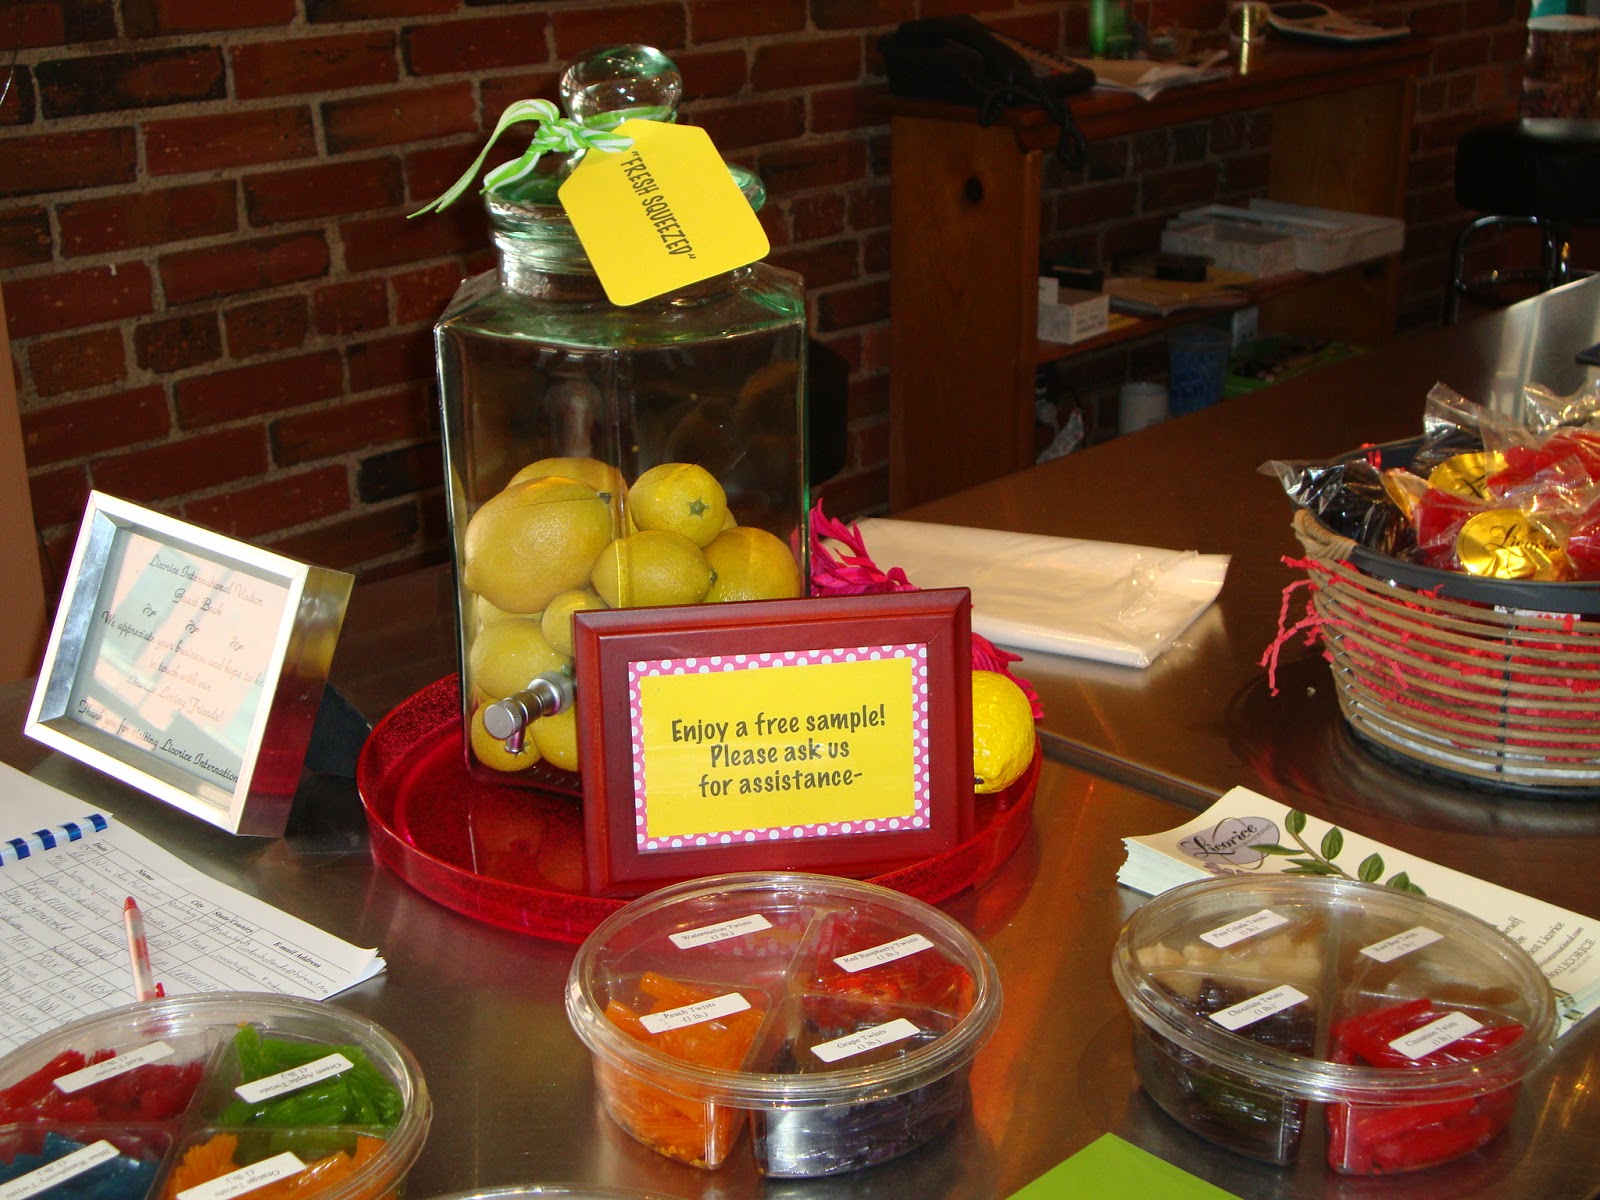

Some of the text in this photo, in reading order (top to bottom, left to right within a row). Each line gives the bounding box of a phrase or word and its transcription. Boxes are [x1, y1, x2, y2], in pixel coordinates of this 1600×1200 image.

[620, 151, 696, 259] "FRESH SQUEEZED"
[148, 554, 263, 606] Licorice International Visitor
[172, 588, 225, 616] Guest Book
[101, 610, 116, 627] We
[117, 622, 156, 643] appreciate
[156, 638, 174, 650] your
[174, 640, 207, 663] business
[208, 657, 225, 670] and
[224, 660, 243, 681] hope
[243, 671, 253, 683] to
[157, 662, 179, 679] touch
[180, 671, 197, 686] with
[78, 699, 104, 721] Thank
[105, 717, 118, 730] you
[116, 717, 131, 735] for
[131, 729, 159, 751] visiting
[160, 738, 192, 762] Licorice
[671, 703, 885, 744] Enjoy a free sample!
[710, 738, 850, 768] Please ask us
[699, 770, 863, 797] for assistance-
[1180, 824, 1257, 858] Licorice
[136, 869, 155, 881] Name
[191, 899, 204, 908] City
[212, 911, 230, 923] State
[228, 917, 254, 934] Country
[295, 951, 321, 968] Address
[681, 920, 752, 940] Watermelon Twists
[1537, 921, 1565, 946] Licorice
[843, 955, 859, 963] Red
[894, 937, 919, 948] Twists
[663, 1003, 716, 1020] Peach Twists
[1228, 992, 1284, 1017] Chocolate Twists
[837, 1029, 887, 1048] Grape Twists
[259, 1062, 342, 1094] Green Apple Twists
[88, 1148, 111, 1160] Blue
[246, 1169, 281, 1184] Orange
